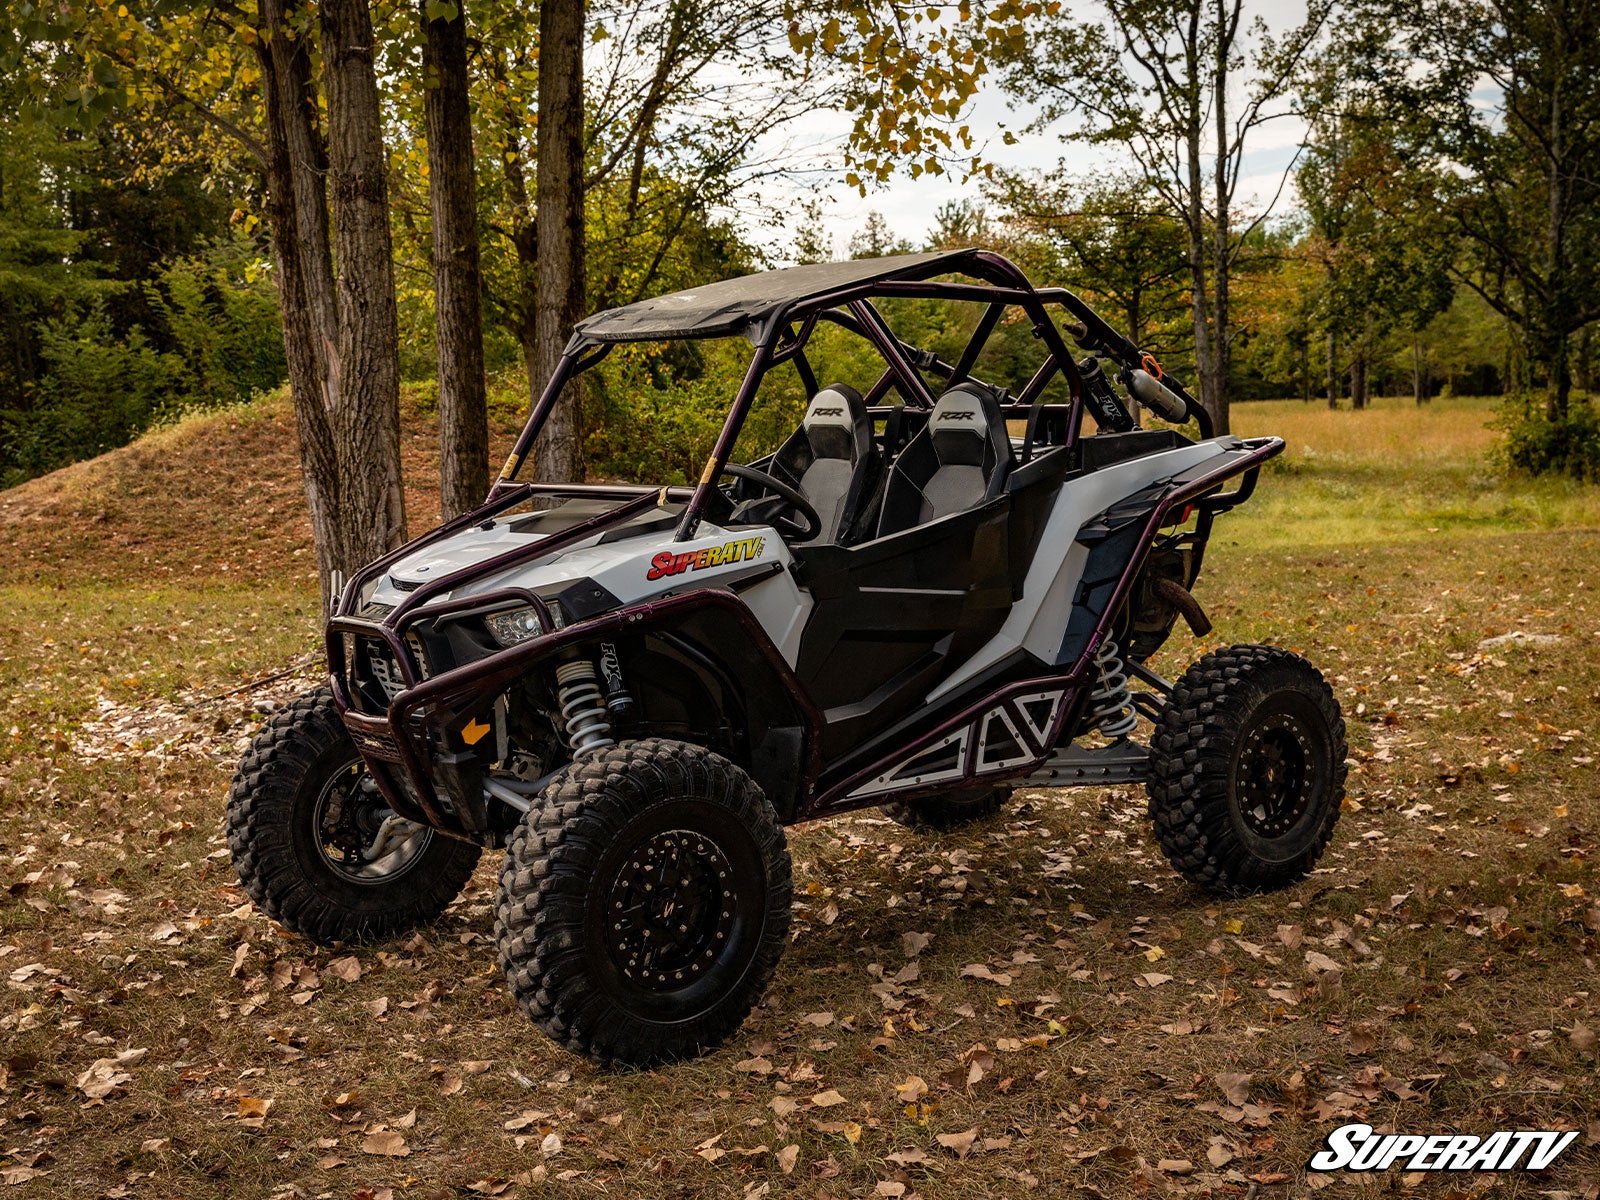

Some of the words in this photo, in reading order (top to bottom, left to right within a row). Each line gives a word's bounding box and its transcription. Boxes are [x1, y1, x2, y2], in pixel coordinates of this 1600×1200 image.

[811, 407, 844, 418] RZR
[937, 411, 976, 422] RZR
[1100, 395, 1122, 421] FOX
[646, 536, 762, 581] SUPERATV
[600, 642, 622, 684] FOX
